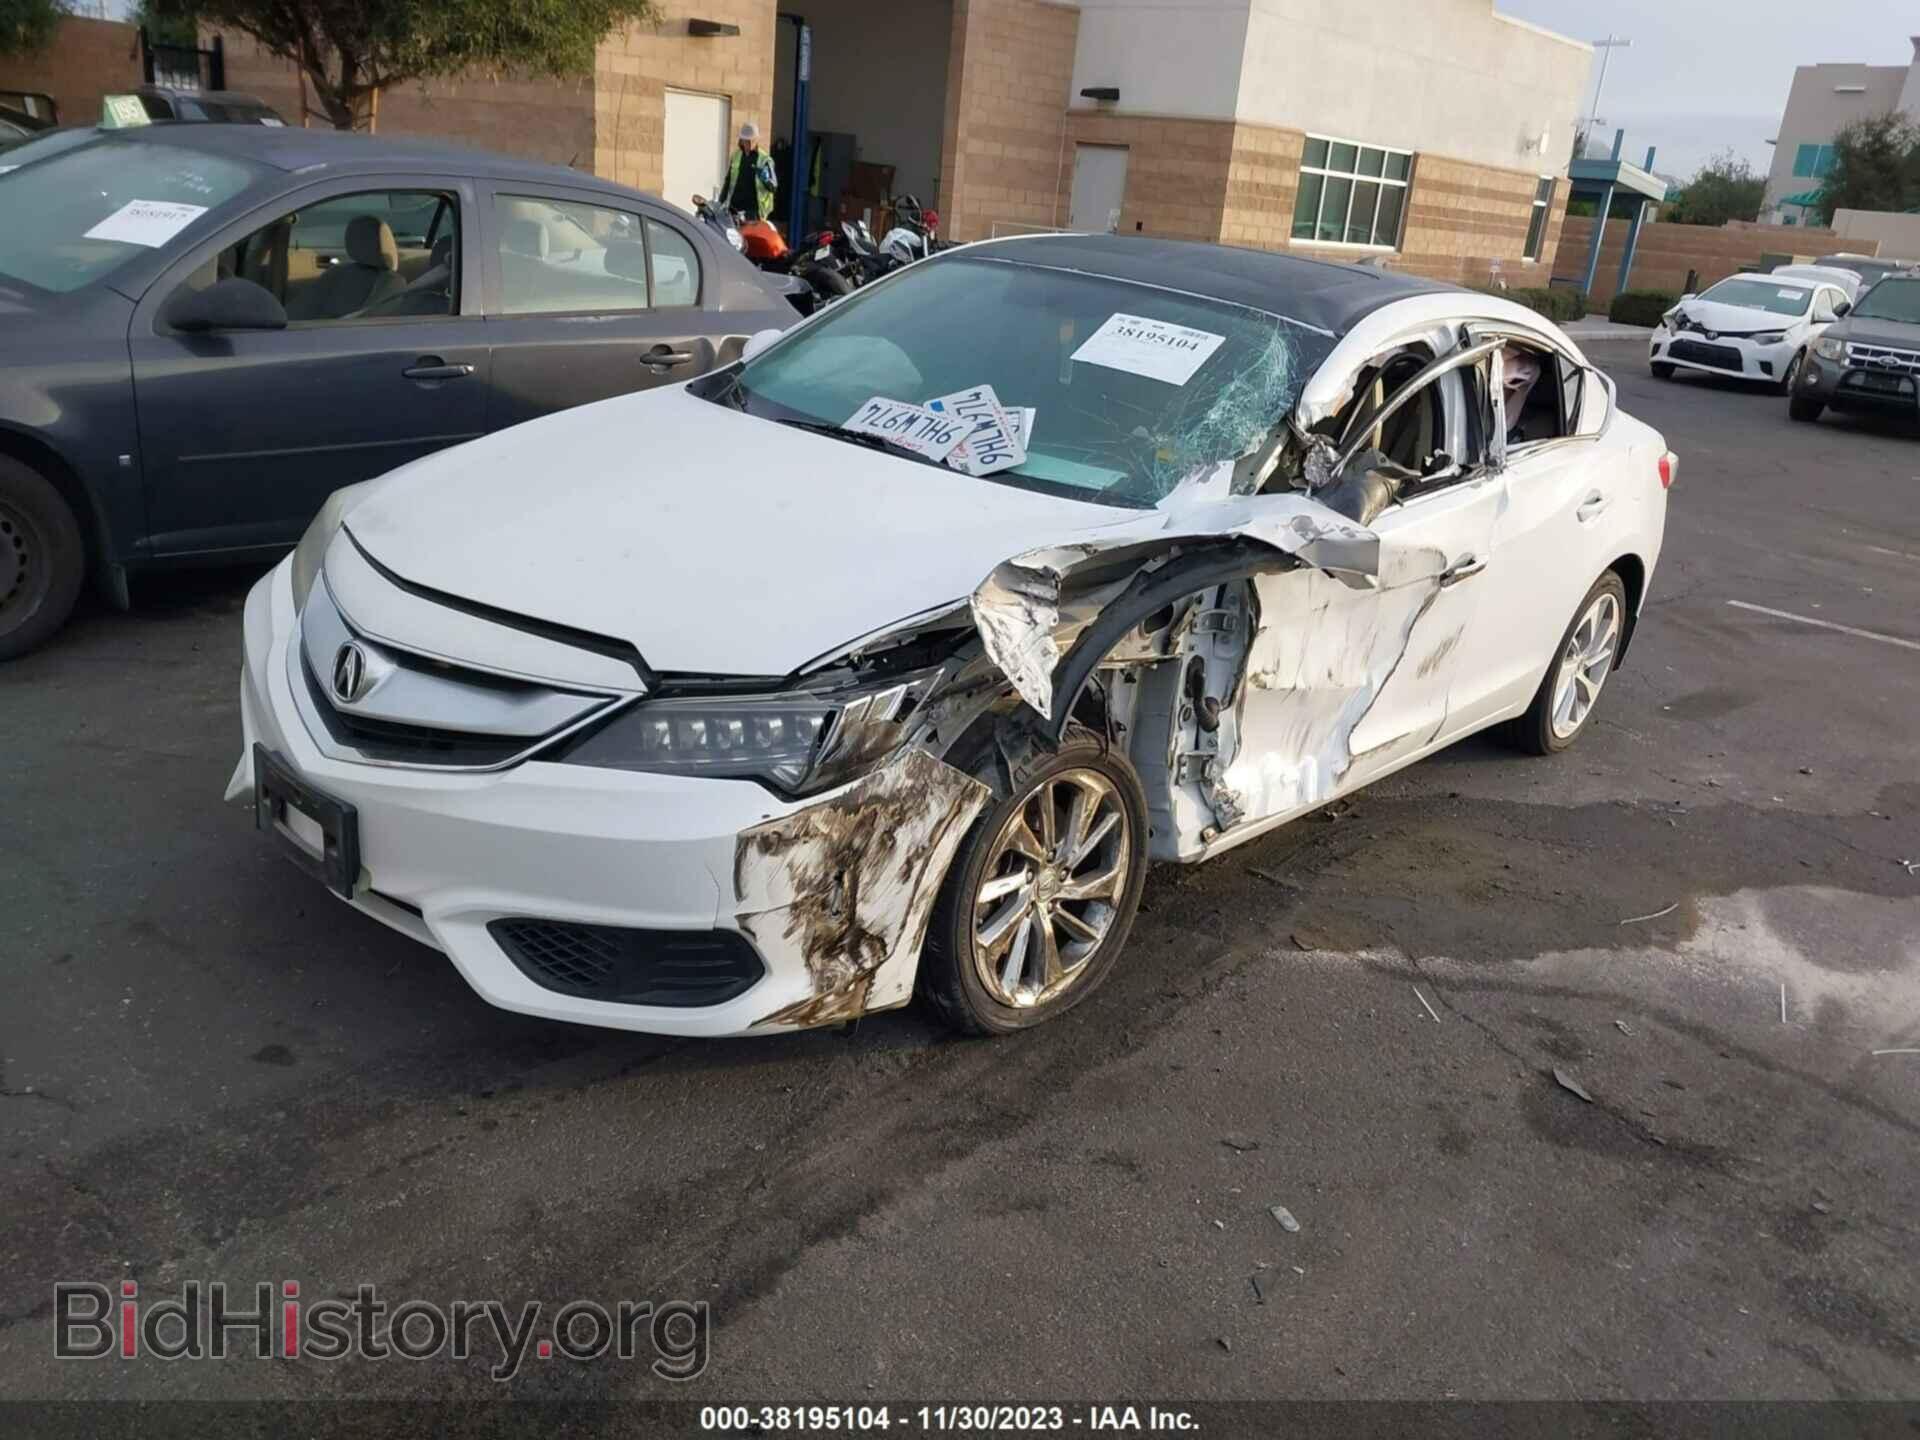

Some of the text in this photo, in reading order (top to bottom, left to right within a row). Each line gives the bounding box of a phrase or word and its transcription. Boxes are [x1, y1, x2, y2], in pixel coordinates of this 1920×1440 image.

[1115, 325, 1199, 351] 38195104
[860, 403, 963, 445] 9HLW974
[952, 391, 1014, 465] 9HLW974
